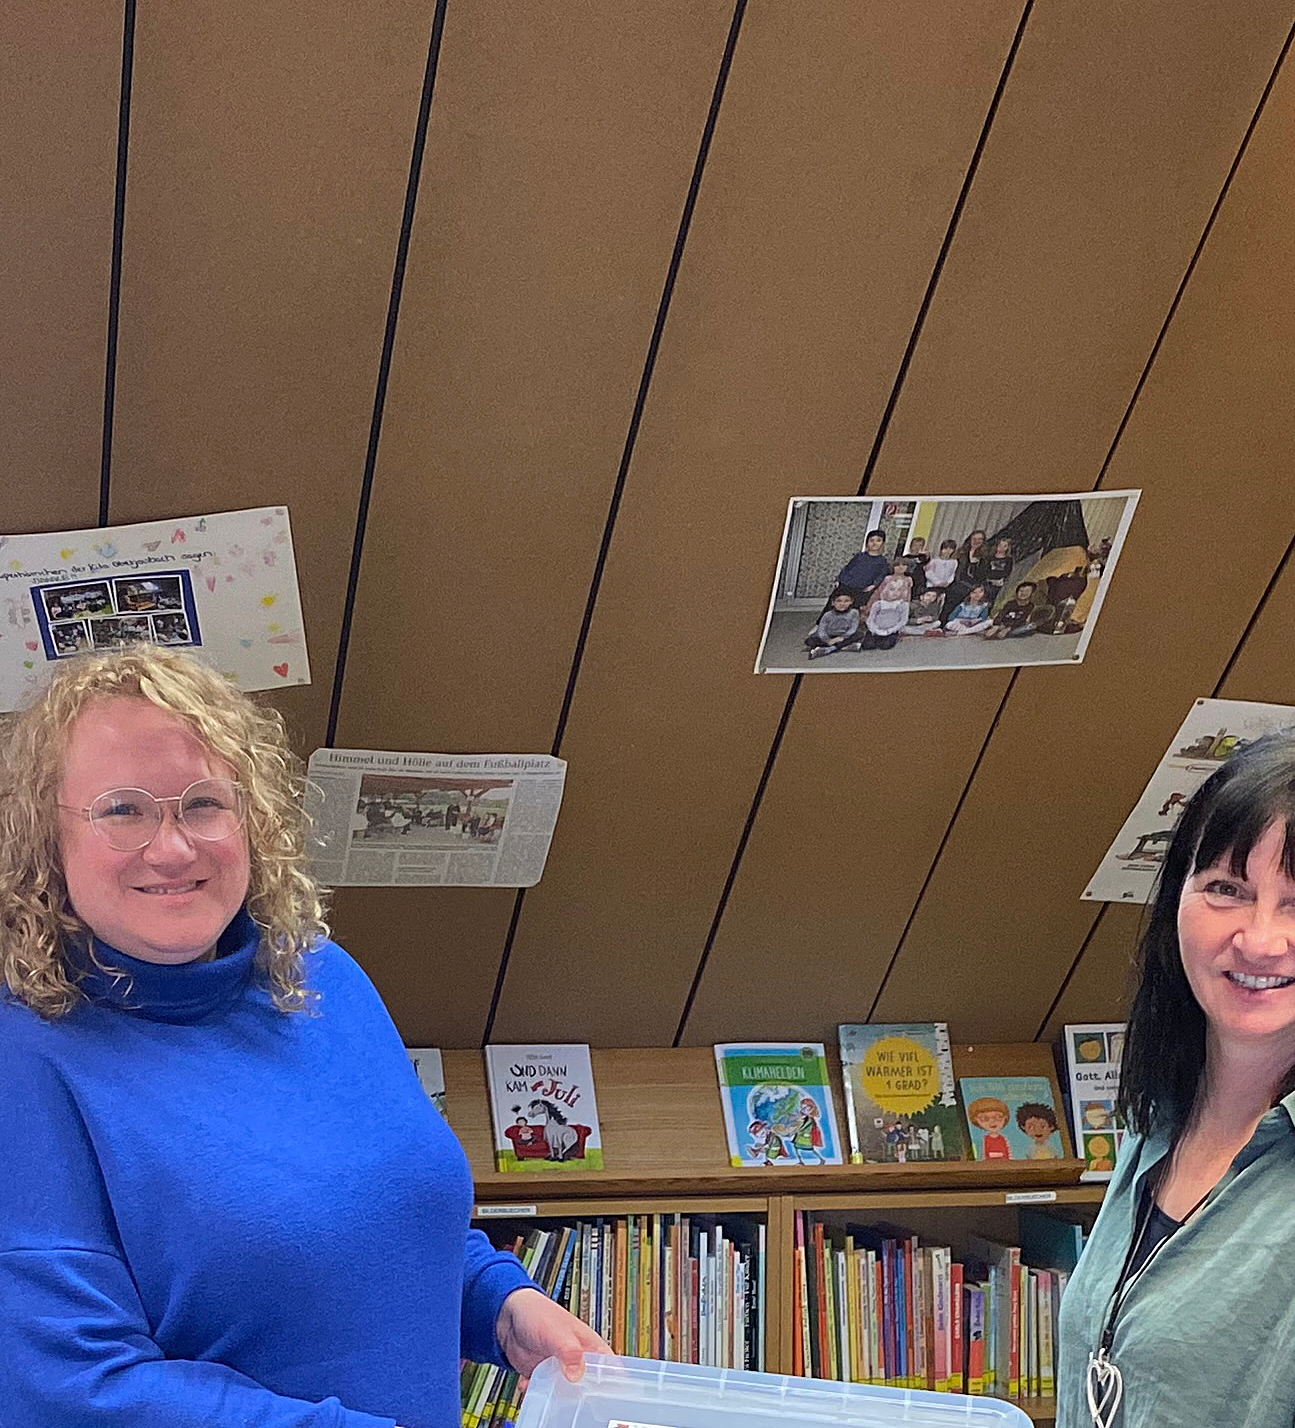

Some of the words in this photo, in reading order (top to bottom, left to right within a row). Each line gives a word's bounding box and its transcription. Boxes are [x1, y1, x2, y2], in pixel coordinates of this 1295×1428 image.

[328, 753, 374, 764] Himmel
[376, 754, 399, 765] und
[403, 755, 432, 767] Hölle
[435, 757, 453, 768] auf
[456, 758, 480, 769] dem
[483, 759, 551, 771] Fußballplatz
[877, 1052, 896, 1062] WIE
[898, 1051, 919, 1063] VIEL
[510, 1063, 537, 1077] UND
[538, 1065, 567, 1077] DANN
[742, 1067, 805, 1080] KLIMAHELDEN
[917, 1065, 933, 1076] IST
[505, 1081, 528, 1093] KAM
[896, 1079, 928, 1091] GRAD?
